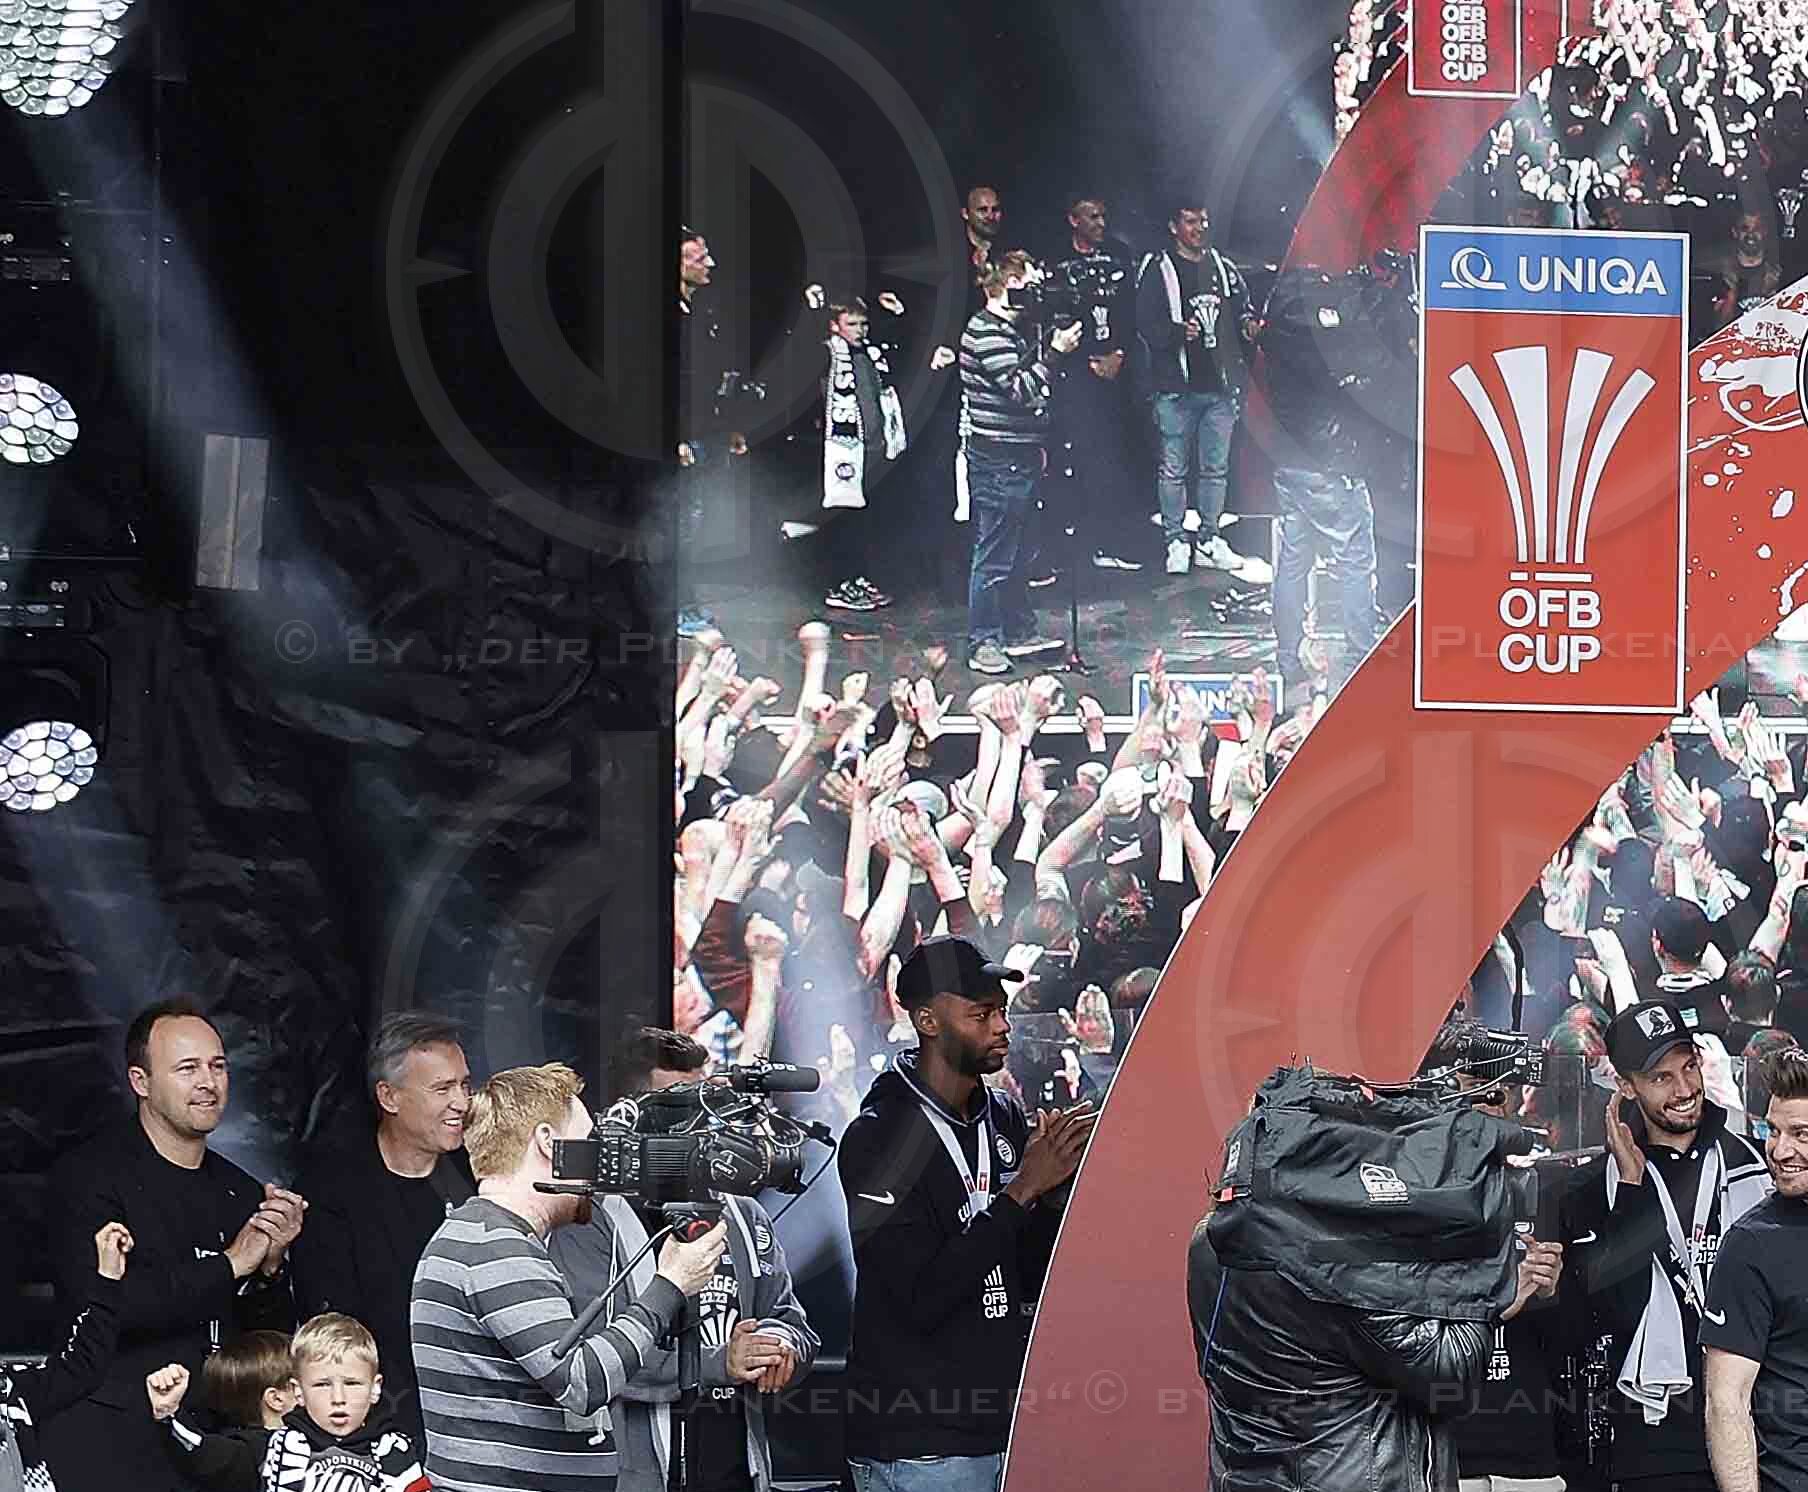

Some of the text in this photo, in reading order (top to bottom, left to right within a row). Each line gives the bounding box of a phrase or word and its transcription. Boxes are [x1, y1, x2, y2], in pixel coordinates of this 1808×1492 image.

[1442, 61, 1487, 81] CUP
[1518, 256, 1667, 295] UNIQA
[1499, 633, 1601, 673] CUP
[984, 1305, 1009, 1319] CUP
[712, 1387, 735, 1400] CUP
